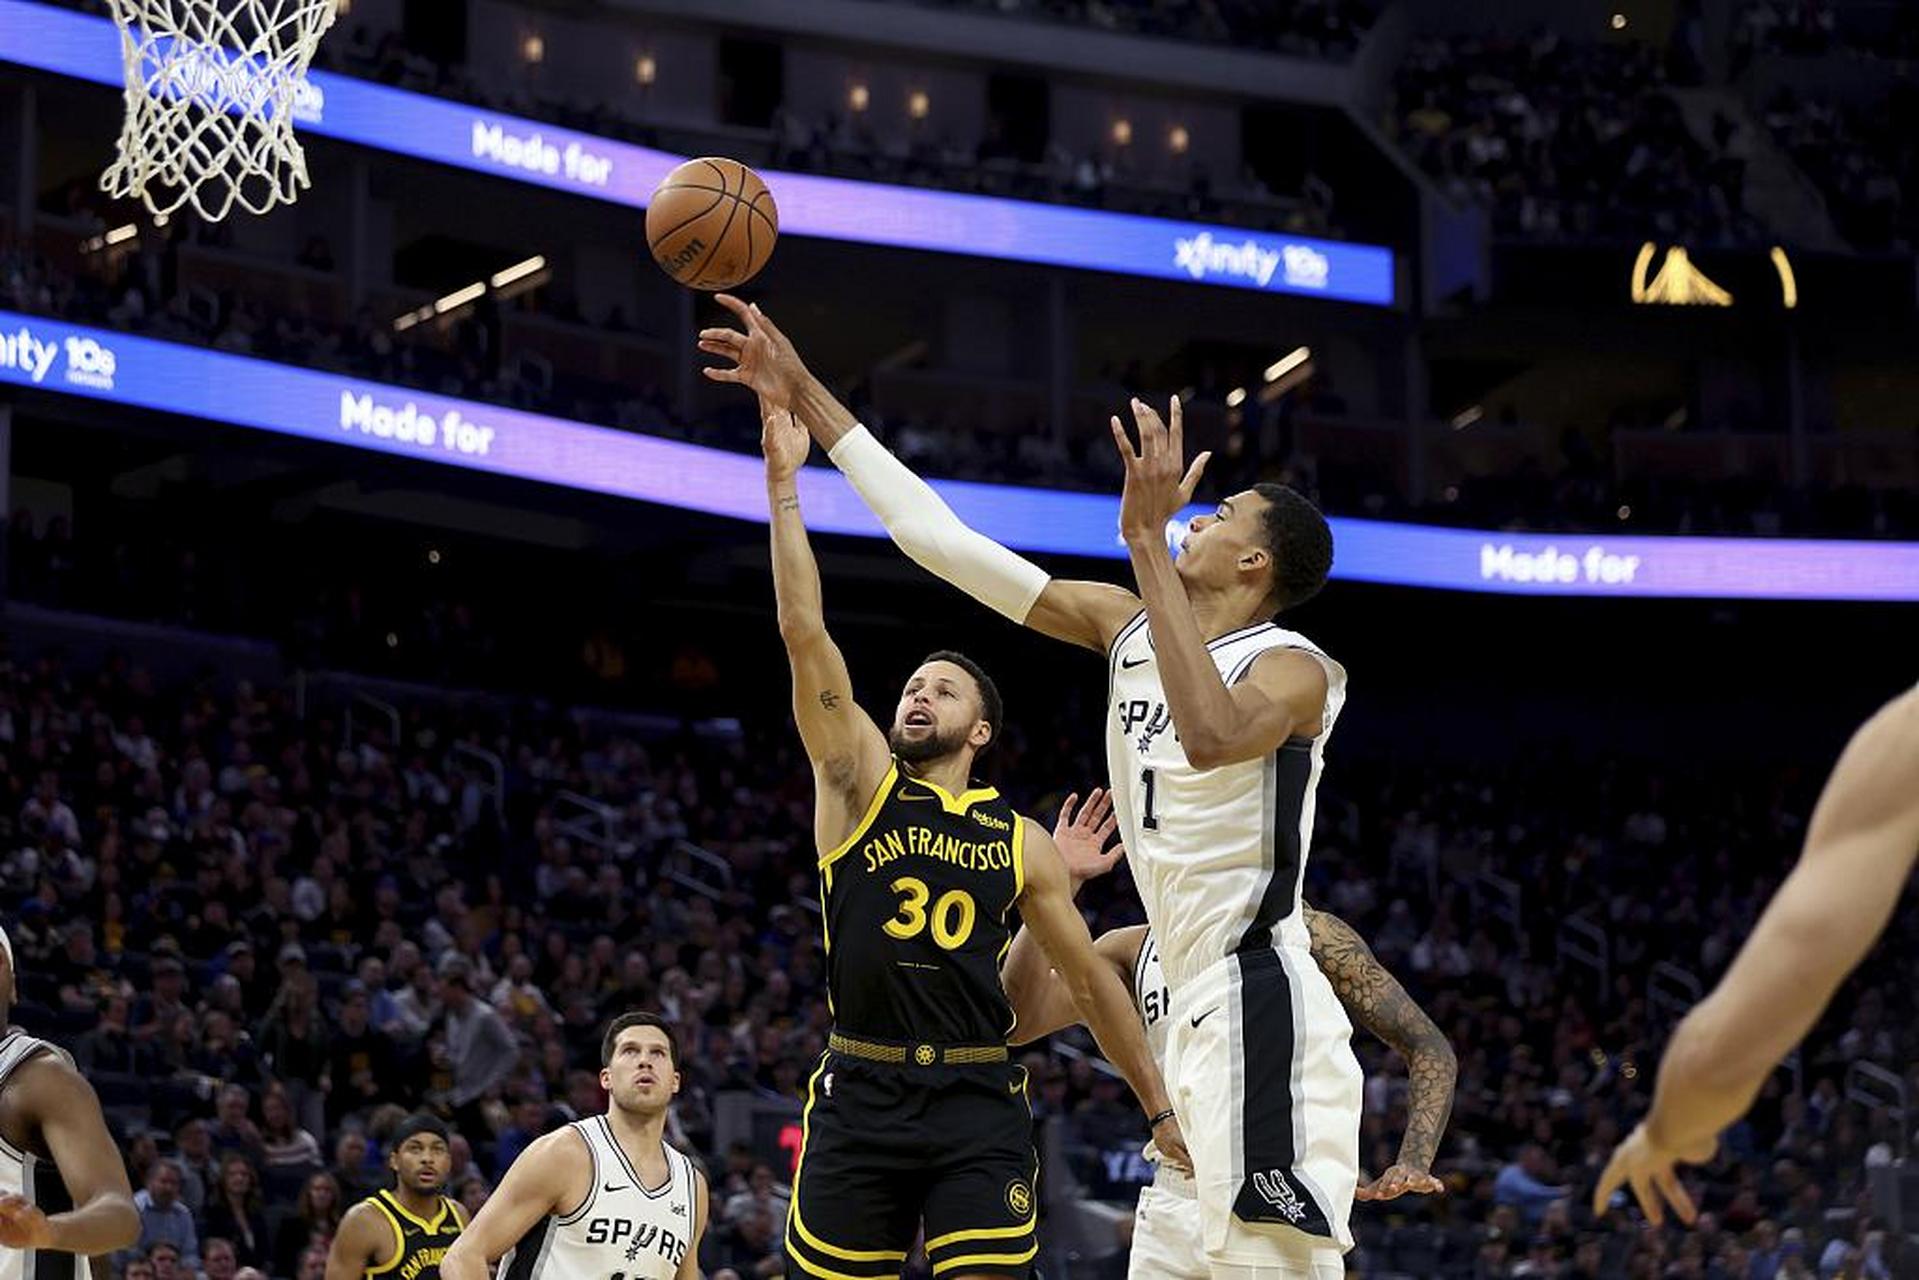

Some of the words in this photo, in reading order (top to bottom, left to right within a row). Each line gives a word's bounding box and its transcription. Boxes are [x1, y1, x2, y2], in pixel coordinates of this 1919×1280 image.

[472, 120, 560, 175] Made
[565, 141, 613, 186] for
[1174, 231, 1281, 288] xfinity
[341, 389, 436, 446] Made
[441, 410, 494, 455] for
[1481, 543, 1578, 583] Made
[1584, 546, 1640, 584] for
[1141, 767, 1157, 830] 1
[864, 830, 906, 872] SAN
[907, 826, 1011, 870] FRANCISCO
[881, 876, 976, 951] 30
